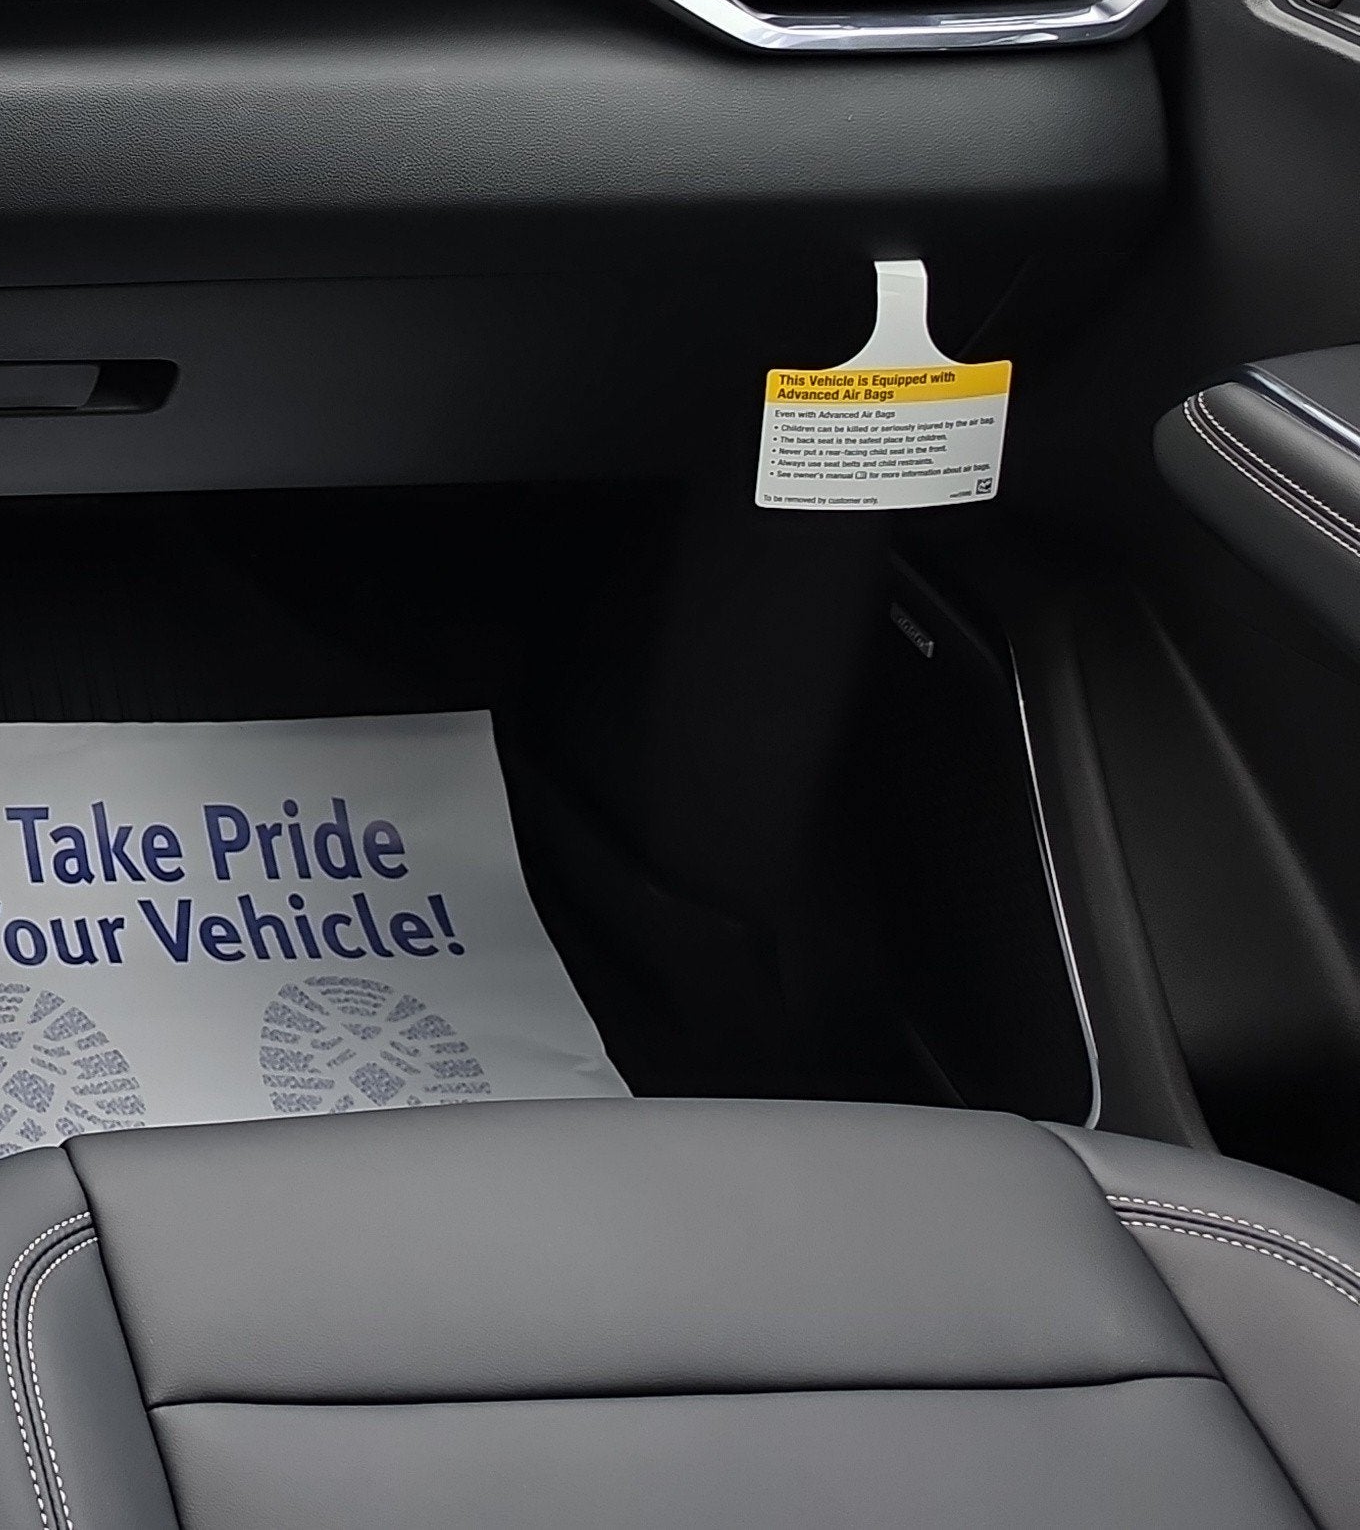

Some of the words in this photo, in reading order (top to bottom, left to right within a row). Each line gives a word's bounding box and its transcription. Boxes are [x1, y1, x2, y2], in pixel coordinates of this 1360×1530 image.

[779, 374, 805, 386] This
[809, 375, 854, 386] Vehicle
[857, 375, 869, 386] is
[871, 373, 927, 387] Equipped
[930, 371, 956, 384] with
[777, 388, 840, 400] Advanced
[842, 388, 861, 400] Air
[863, 388, 895, 402] Bags
[774, 410, 796, 418] Even
[818, 411, 860, 419] Advanced
[875, 410, 896, 419] Bags
[781, 423, 815, 432] Children
[834, 425, 845, 433] be
[846, 425, 869, 433] killed
[881, 423, 916, 432] seriously
[917, 422, 944, 430] injured
[945, 421, 954, 430] by
[969, 418, 979, 426] air
[883, 436, 904, 444] place
[818, 497, 826, 505] by
[5, 800, 185, 884] Take
[202, 797, 407, 880] Pride
[137, 892, 467, 965] Vehicle!
